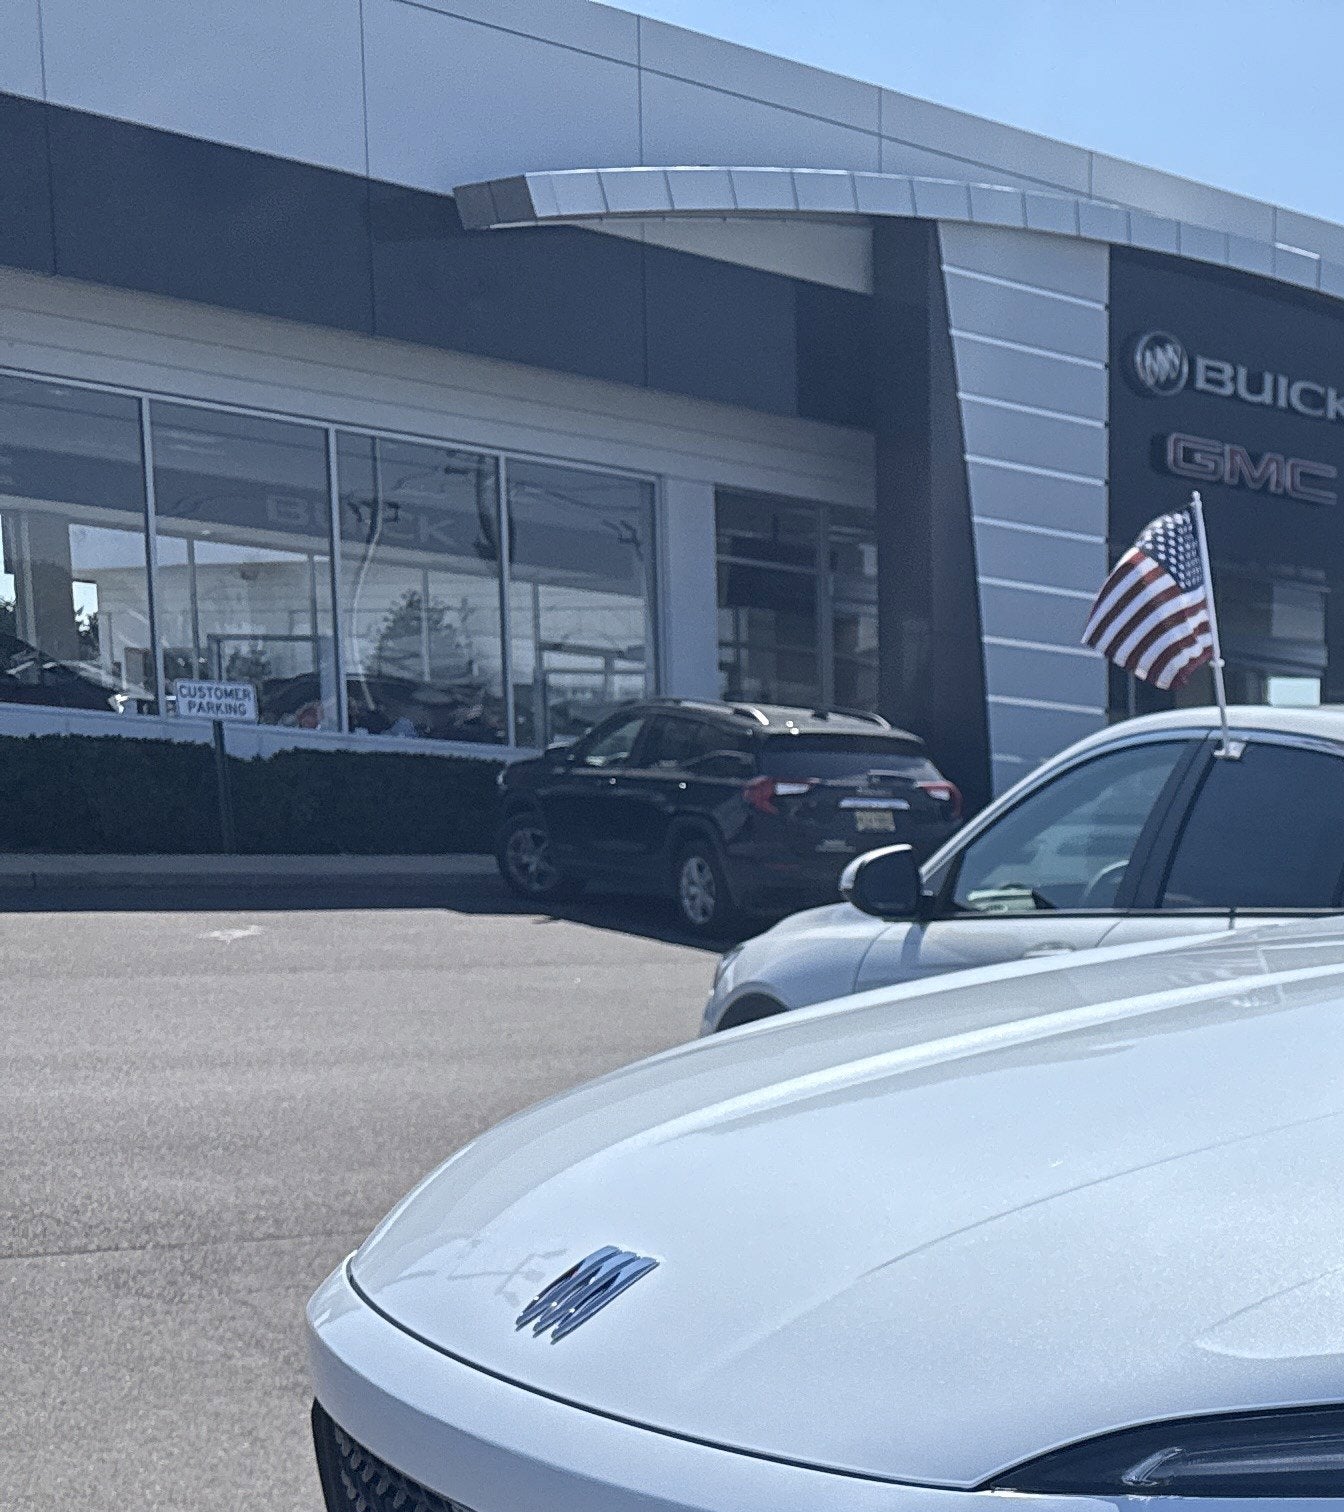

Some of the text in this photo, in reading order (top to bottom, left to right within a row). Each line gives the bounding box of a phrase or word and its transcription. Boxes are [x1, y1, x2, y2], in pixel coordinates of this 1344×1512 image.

[1166, 432, 1340, 506] GMC
[179, 684, 252, 700] CUSTOMER
[188, 700, 247, 716] PARKING
